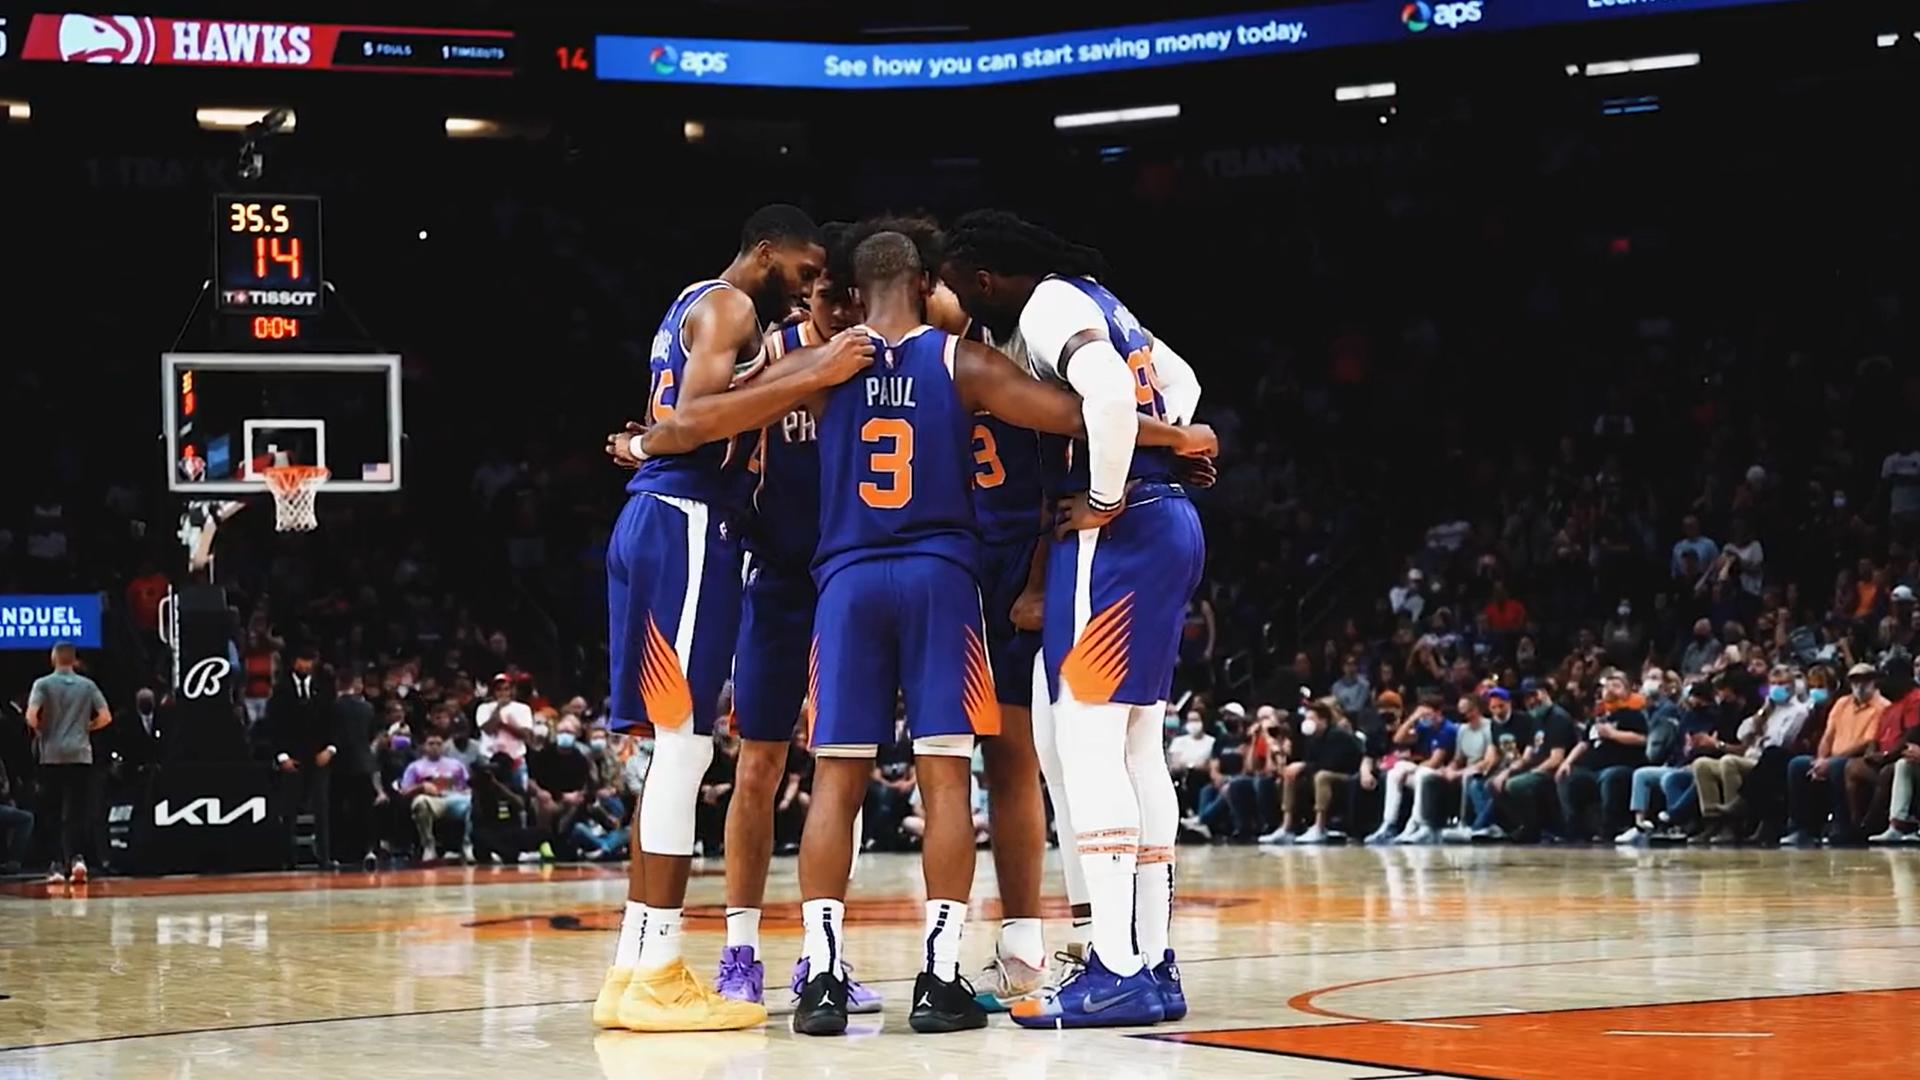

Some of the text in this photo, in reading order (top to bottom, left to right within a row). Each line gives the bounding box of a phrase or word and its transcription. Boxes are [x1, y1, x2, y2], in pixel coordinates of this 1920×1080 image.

[1433, 0, 1483, 28] aps
[172, 22, 311, 64] HAWKS
[376, 43, 413, 56] FOULS
[824, 20, 1308, 78] See how you can start saving money today.
[556, 47, 589, 70] 14
[680, 51, 729, 76] aps
[231, 203, 289, 232] 35.5
[256, 237, 301, 279] 14
[248, 291, 317, 305] TISSOT
[254, 316, 298, 338] 0:04
[866, 376, 916, 408] PAUL
[859, 417, 914, 509] 3
[0, 606, 82, 625] NDUEL
